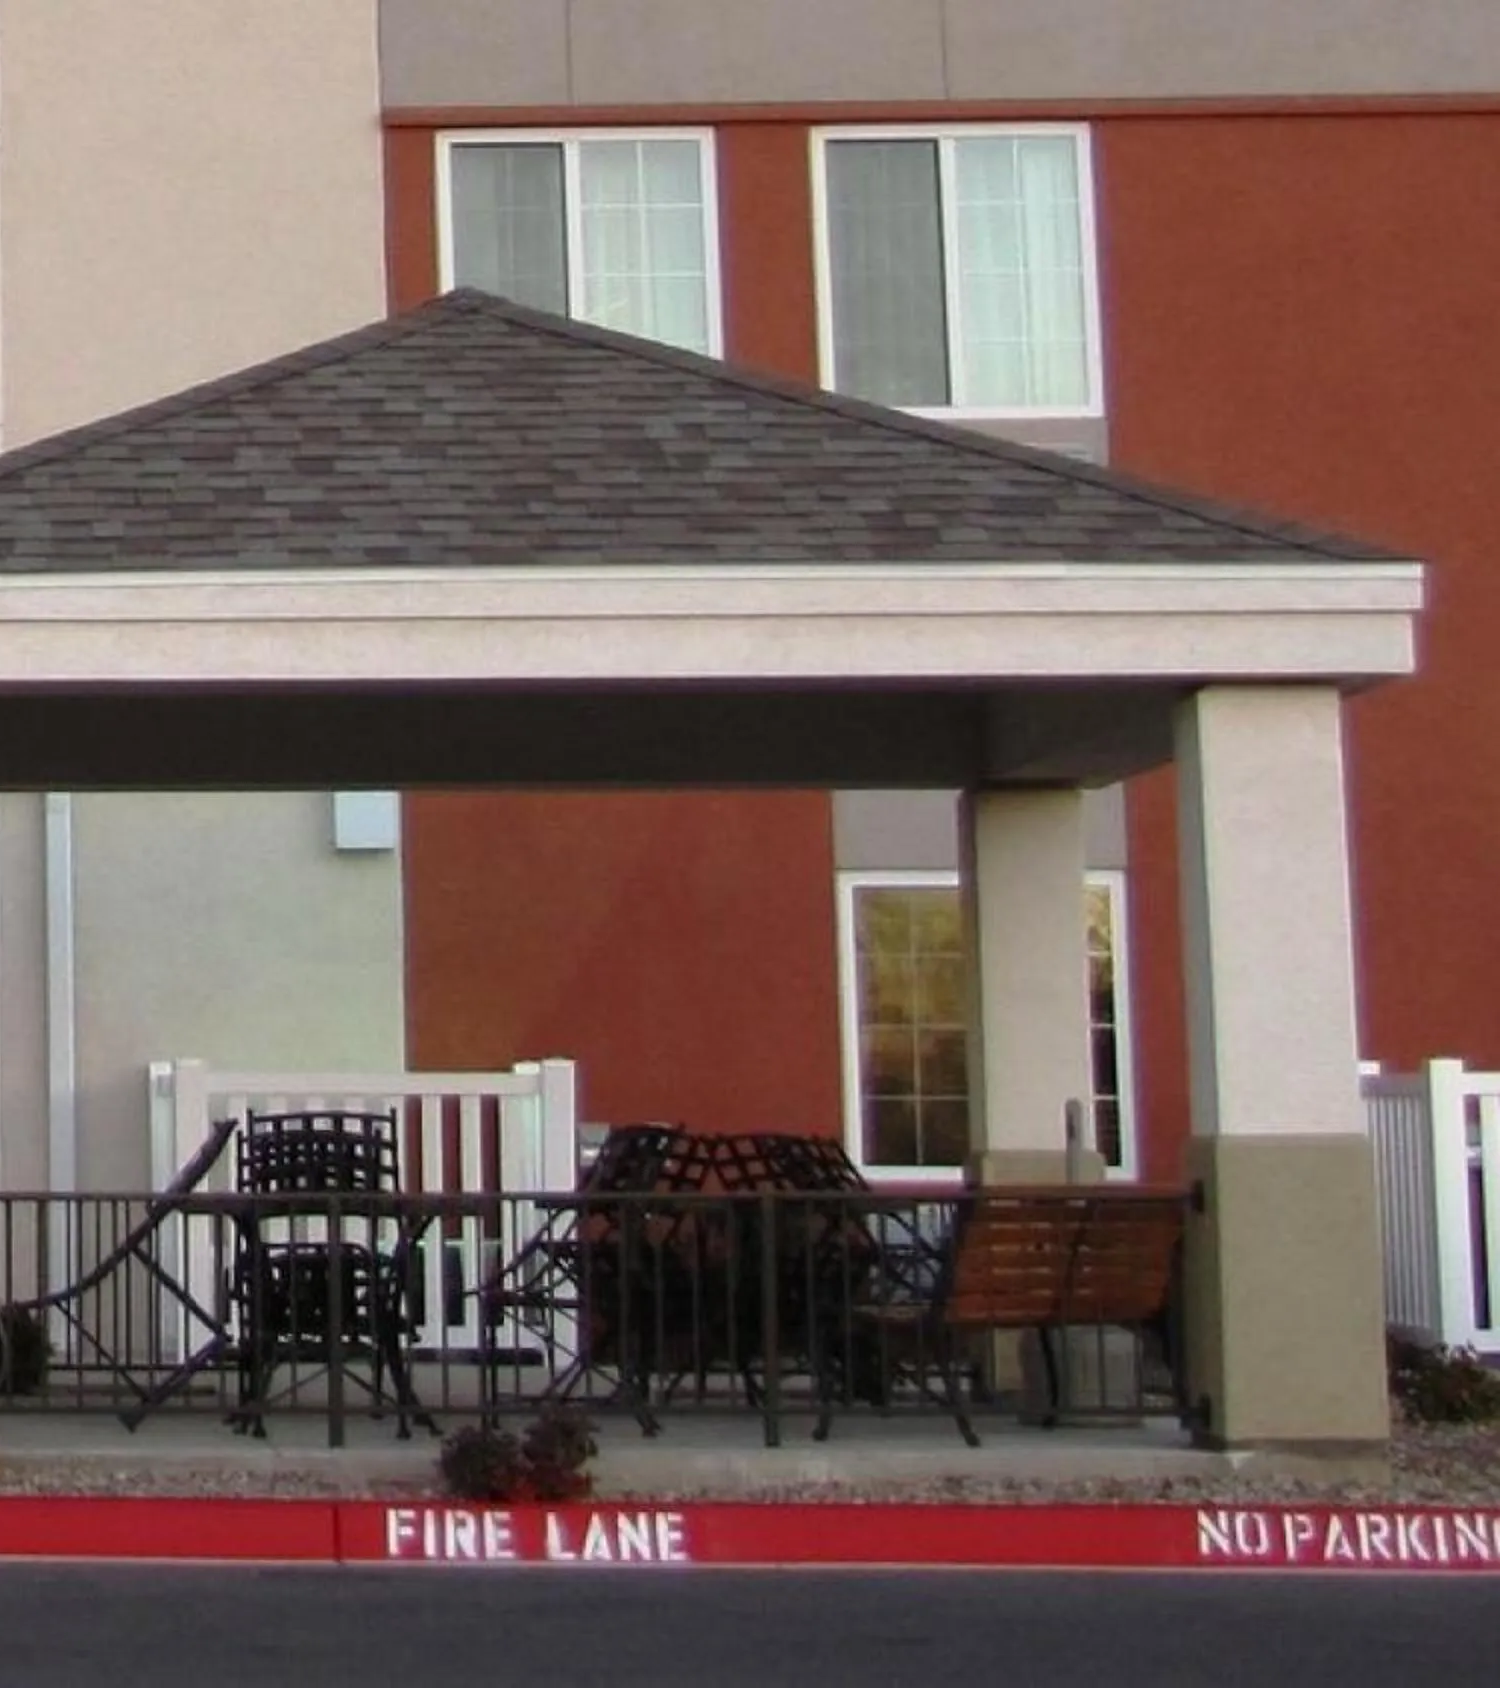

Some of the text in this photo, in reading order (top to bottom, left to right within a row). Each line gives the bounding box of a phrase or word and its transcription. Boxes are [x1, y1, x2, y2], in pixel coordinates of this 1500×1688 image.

[387, 1508, 690, 1561] FIRE LANE
[1198, 1510, 1500, 1562] NO PARKIN
